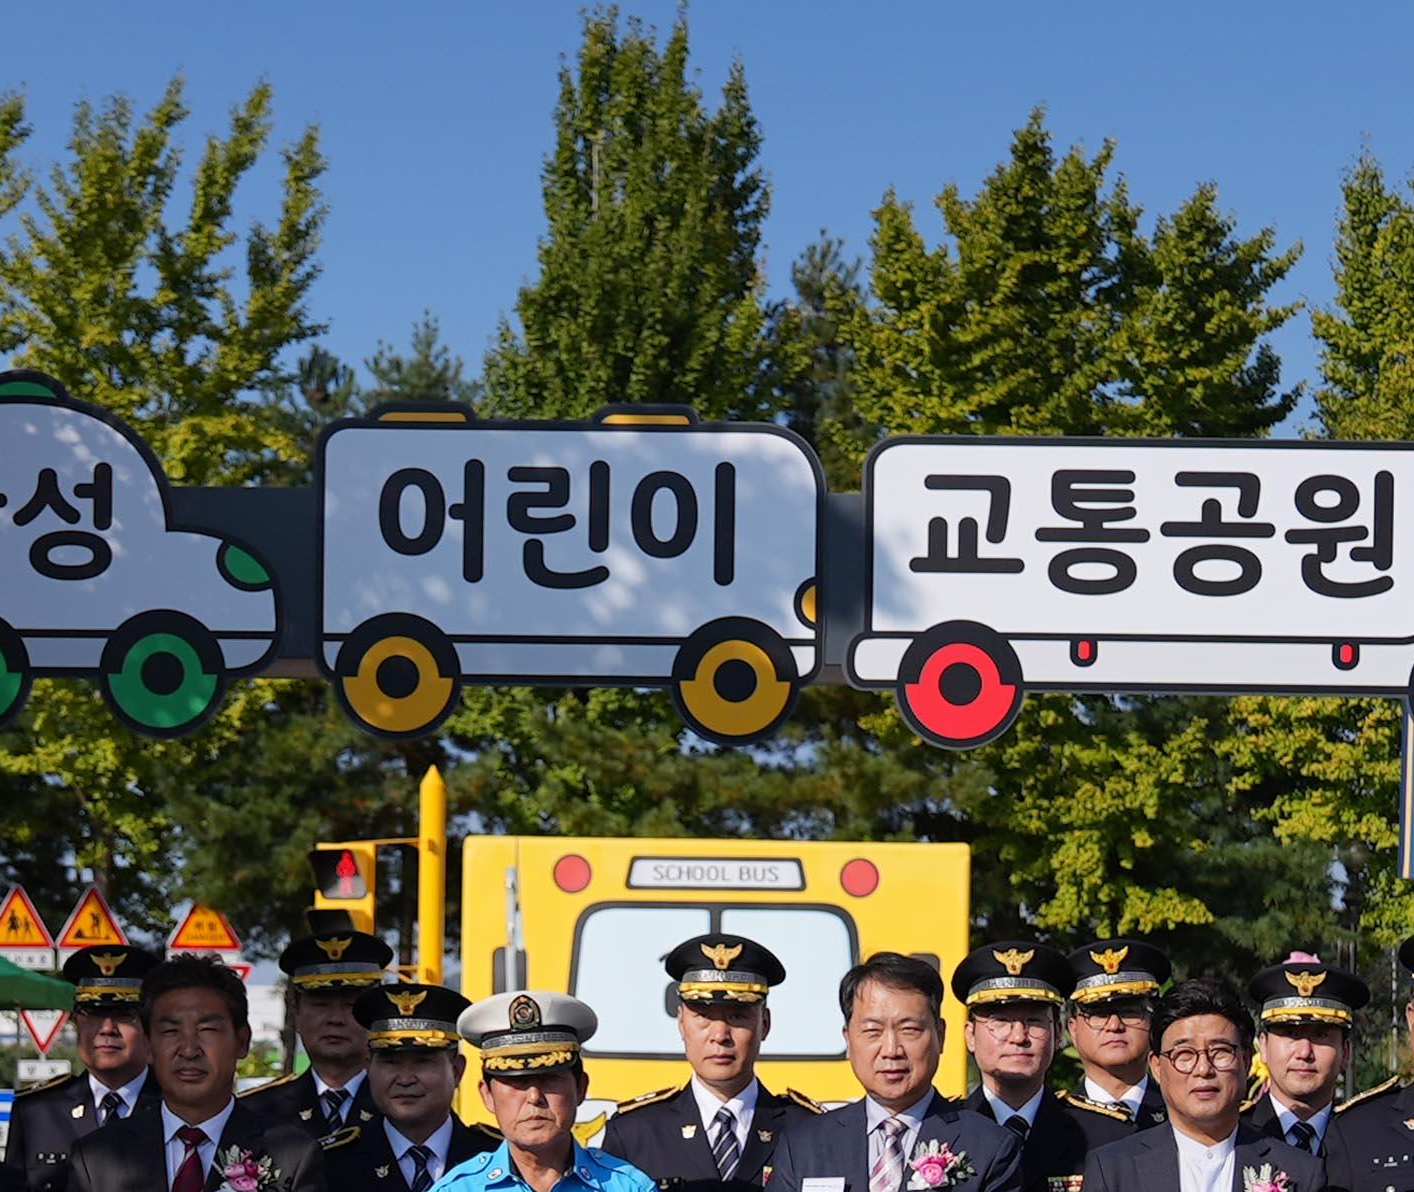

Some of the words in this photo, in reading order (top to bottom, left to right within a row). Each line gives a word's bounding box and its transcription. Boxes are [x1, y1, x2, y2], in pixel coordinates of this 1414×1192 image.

[378, 458, 736, 590] 어린이
[908, 469, 1395, 599] 교통공원
[653, 864, 731, 882] SCHOOL
[739, 866, 779, 882] BUS
